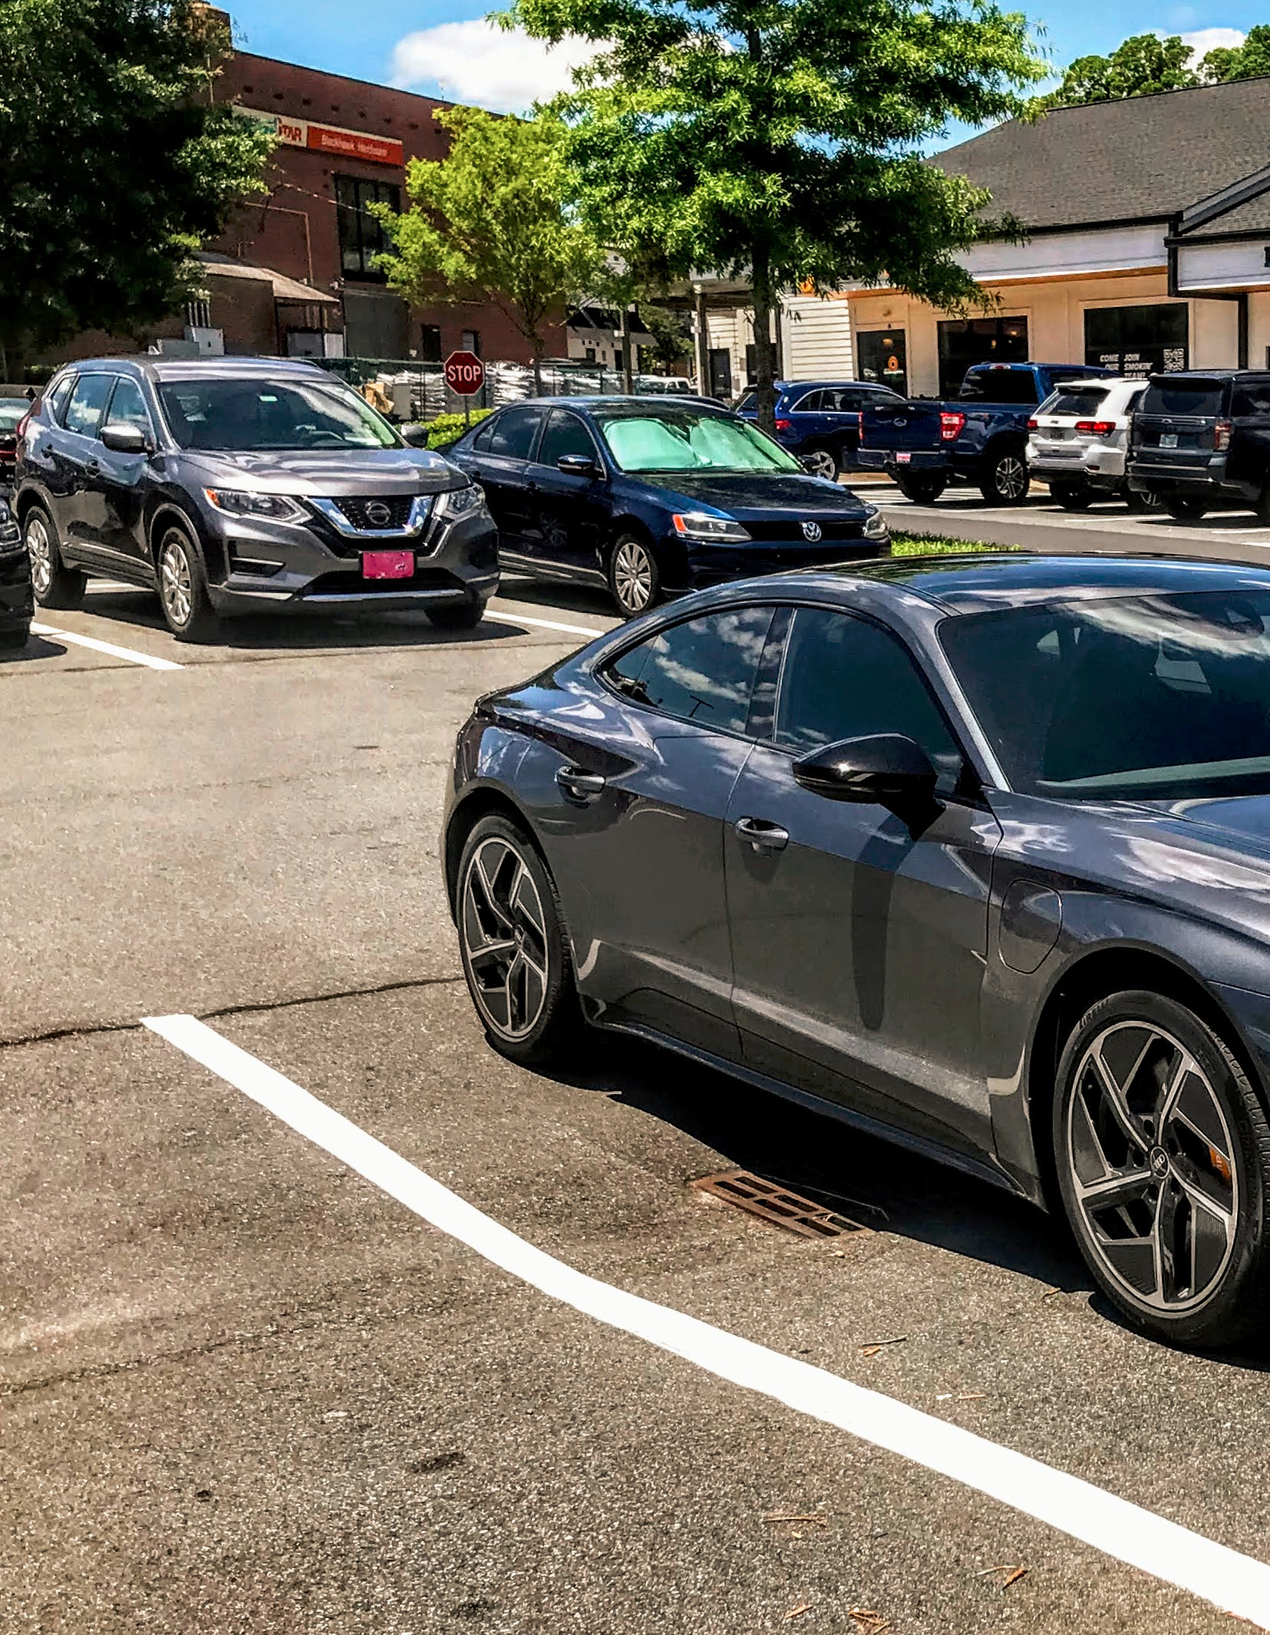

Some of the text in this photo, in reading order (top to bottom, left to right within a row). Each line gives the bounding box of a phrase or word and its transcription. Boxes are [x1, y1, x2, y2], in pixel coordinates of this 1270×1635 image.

[1100, 353, 1140, 362] COME JOIN
[448, 365, 481, 382] STOP
